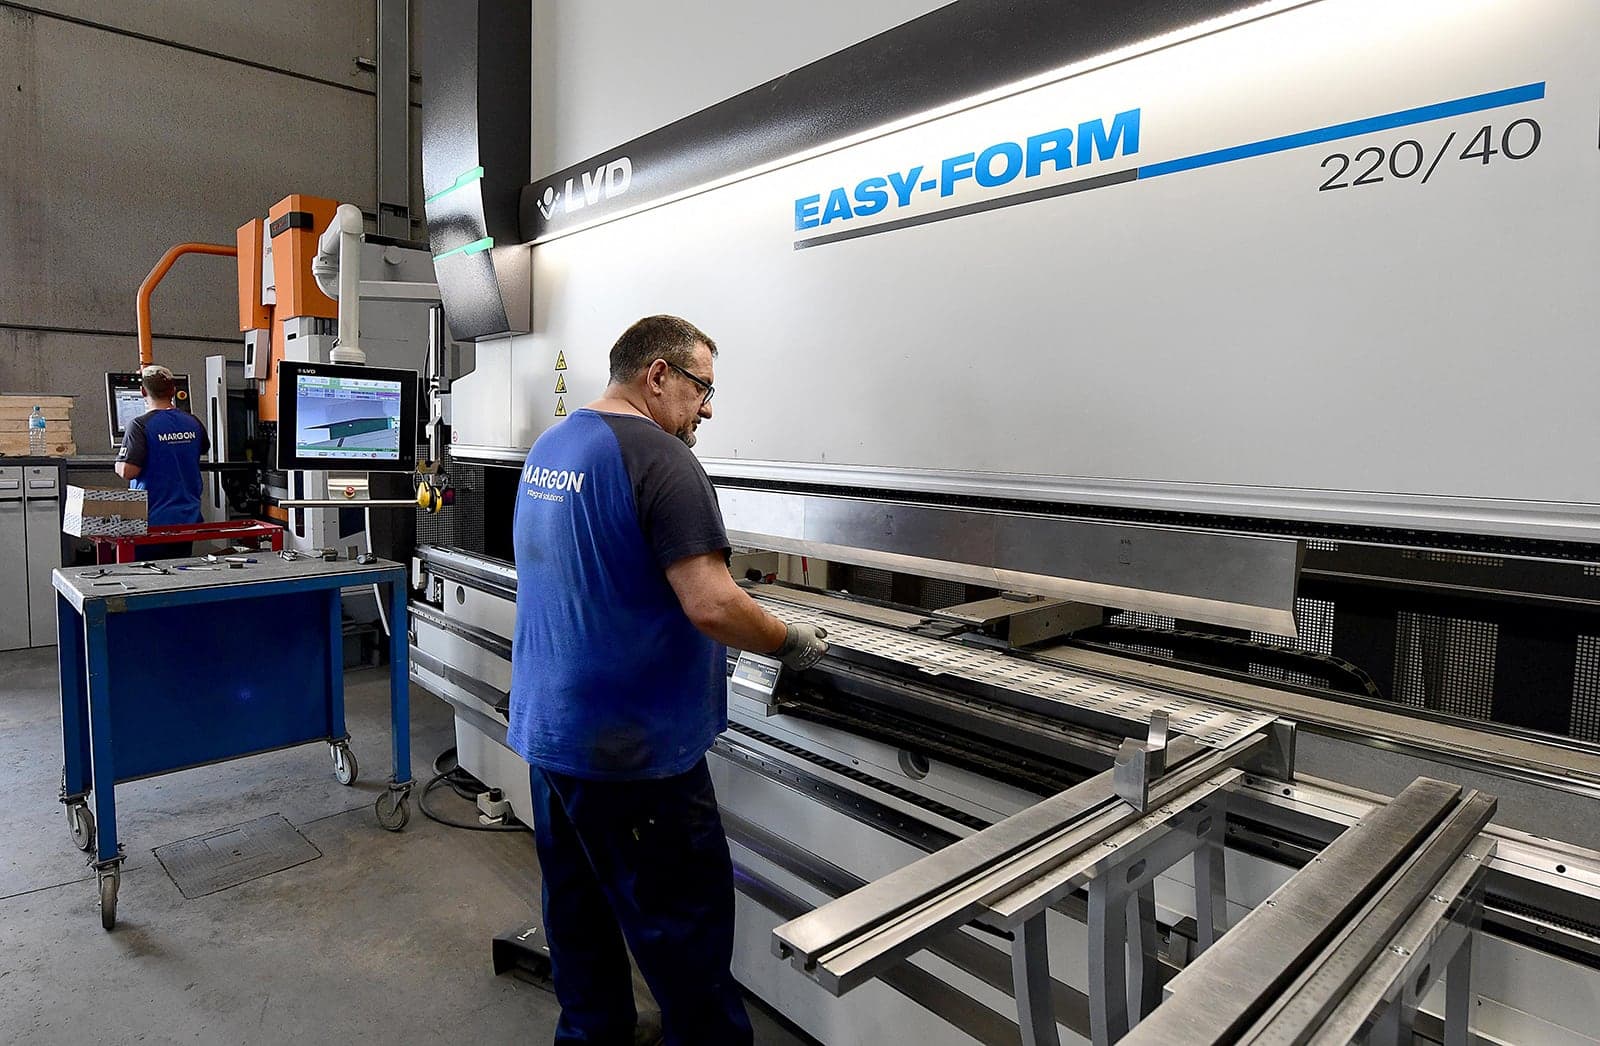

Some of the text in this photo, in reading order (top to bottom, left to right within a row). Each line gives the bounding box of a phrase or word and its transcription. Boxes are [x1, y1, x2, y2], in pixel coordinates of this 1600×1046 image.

[794, 107, 1141, 232] EASY-FORM
[1319, 117, 1542, 192] 220/40
[564, 156, 632, 214] LVD
[157, 431, 196, 442] MARGON
[523, 464, 585, 493] MARGON
